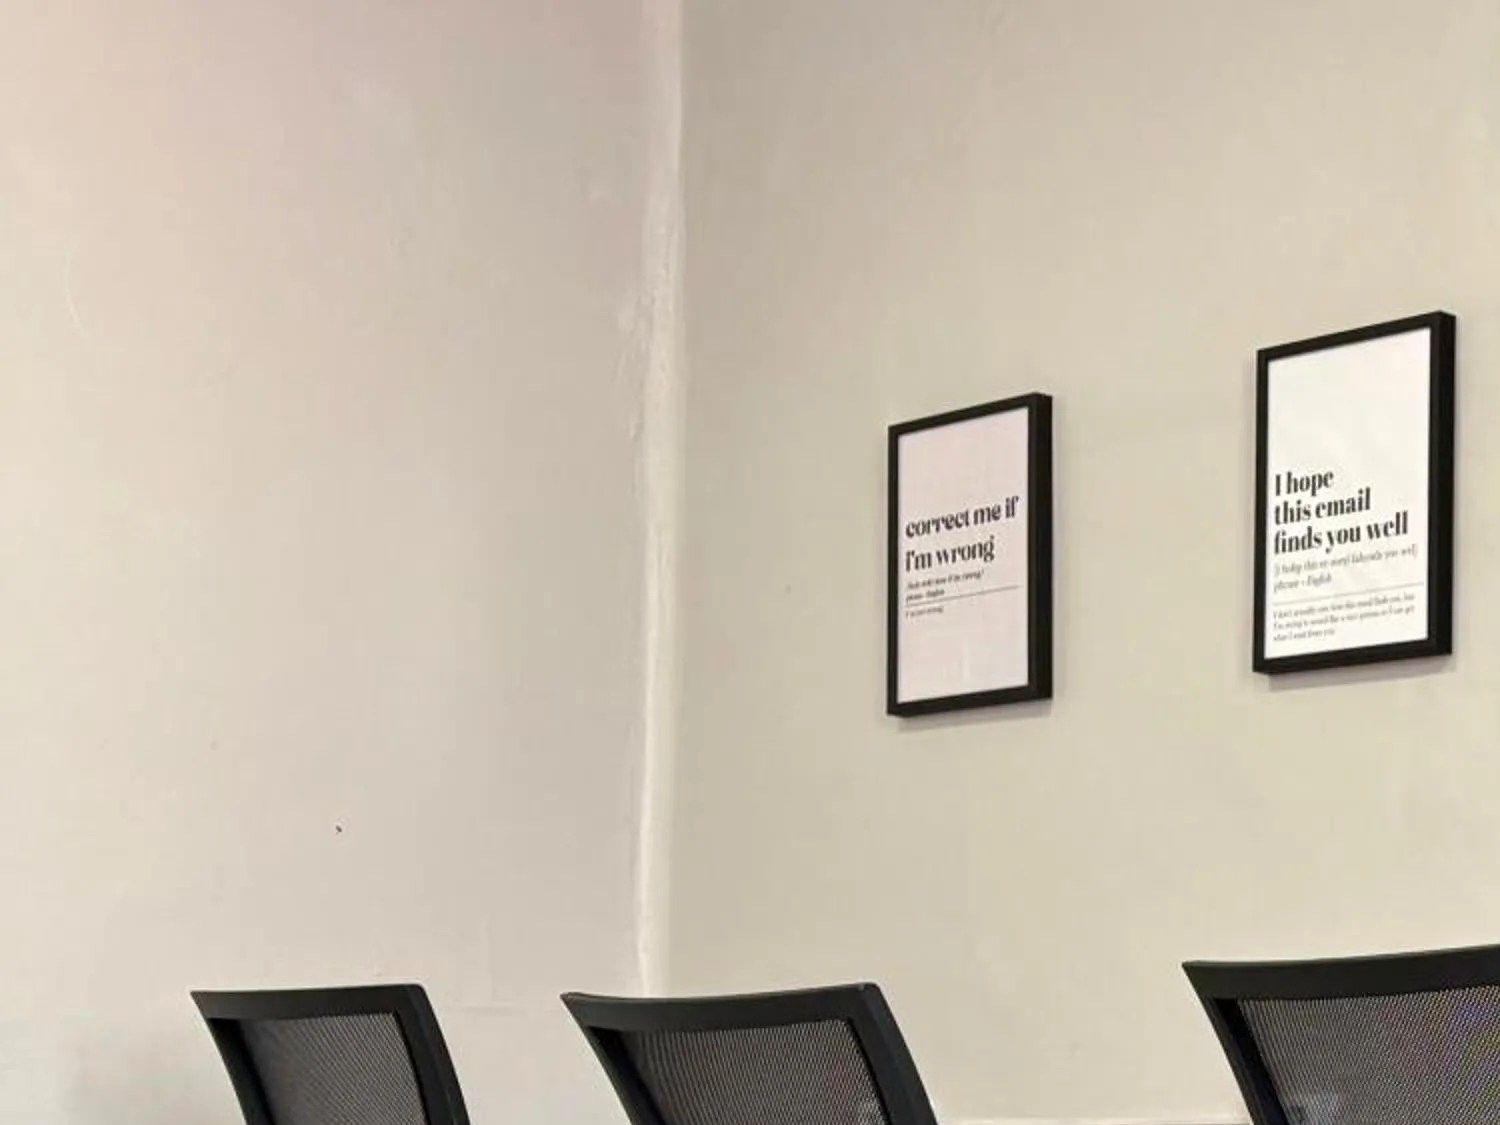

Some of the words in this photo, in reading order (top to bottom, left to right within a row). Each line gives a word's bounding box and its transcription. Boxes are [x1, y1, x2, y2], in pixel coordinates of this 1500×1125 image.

[1275, 474, 1281, 496] I
[1286, 470, 1334, 497] hope
[905, 508, 970, 538] correct
[973, 504, 1001, 525] me
[1005, 495, 1019, 518] if
[1274, 499, 1311, 525] this
[1315, 486, 1371, 519] email
[1274, 525, 1322, 555] finds
[1325, 526, 1361, 554] you
[1367, 510, 1408, 540] well
[906, 549, 932, 572] I'm
[935, 534, 995, 562] wrong
